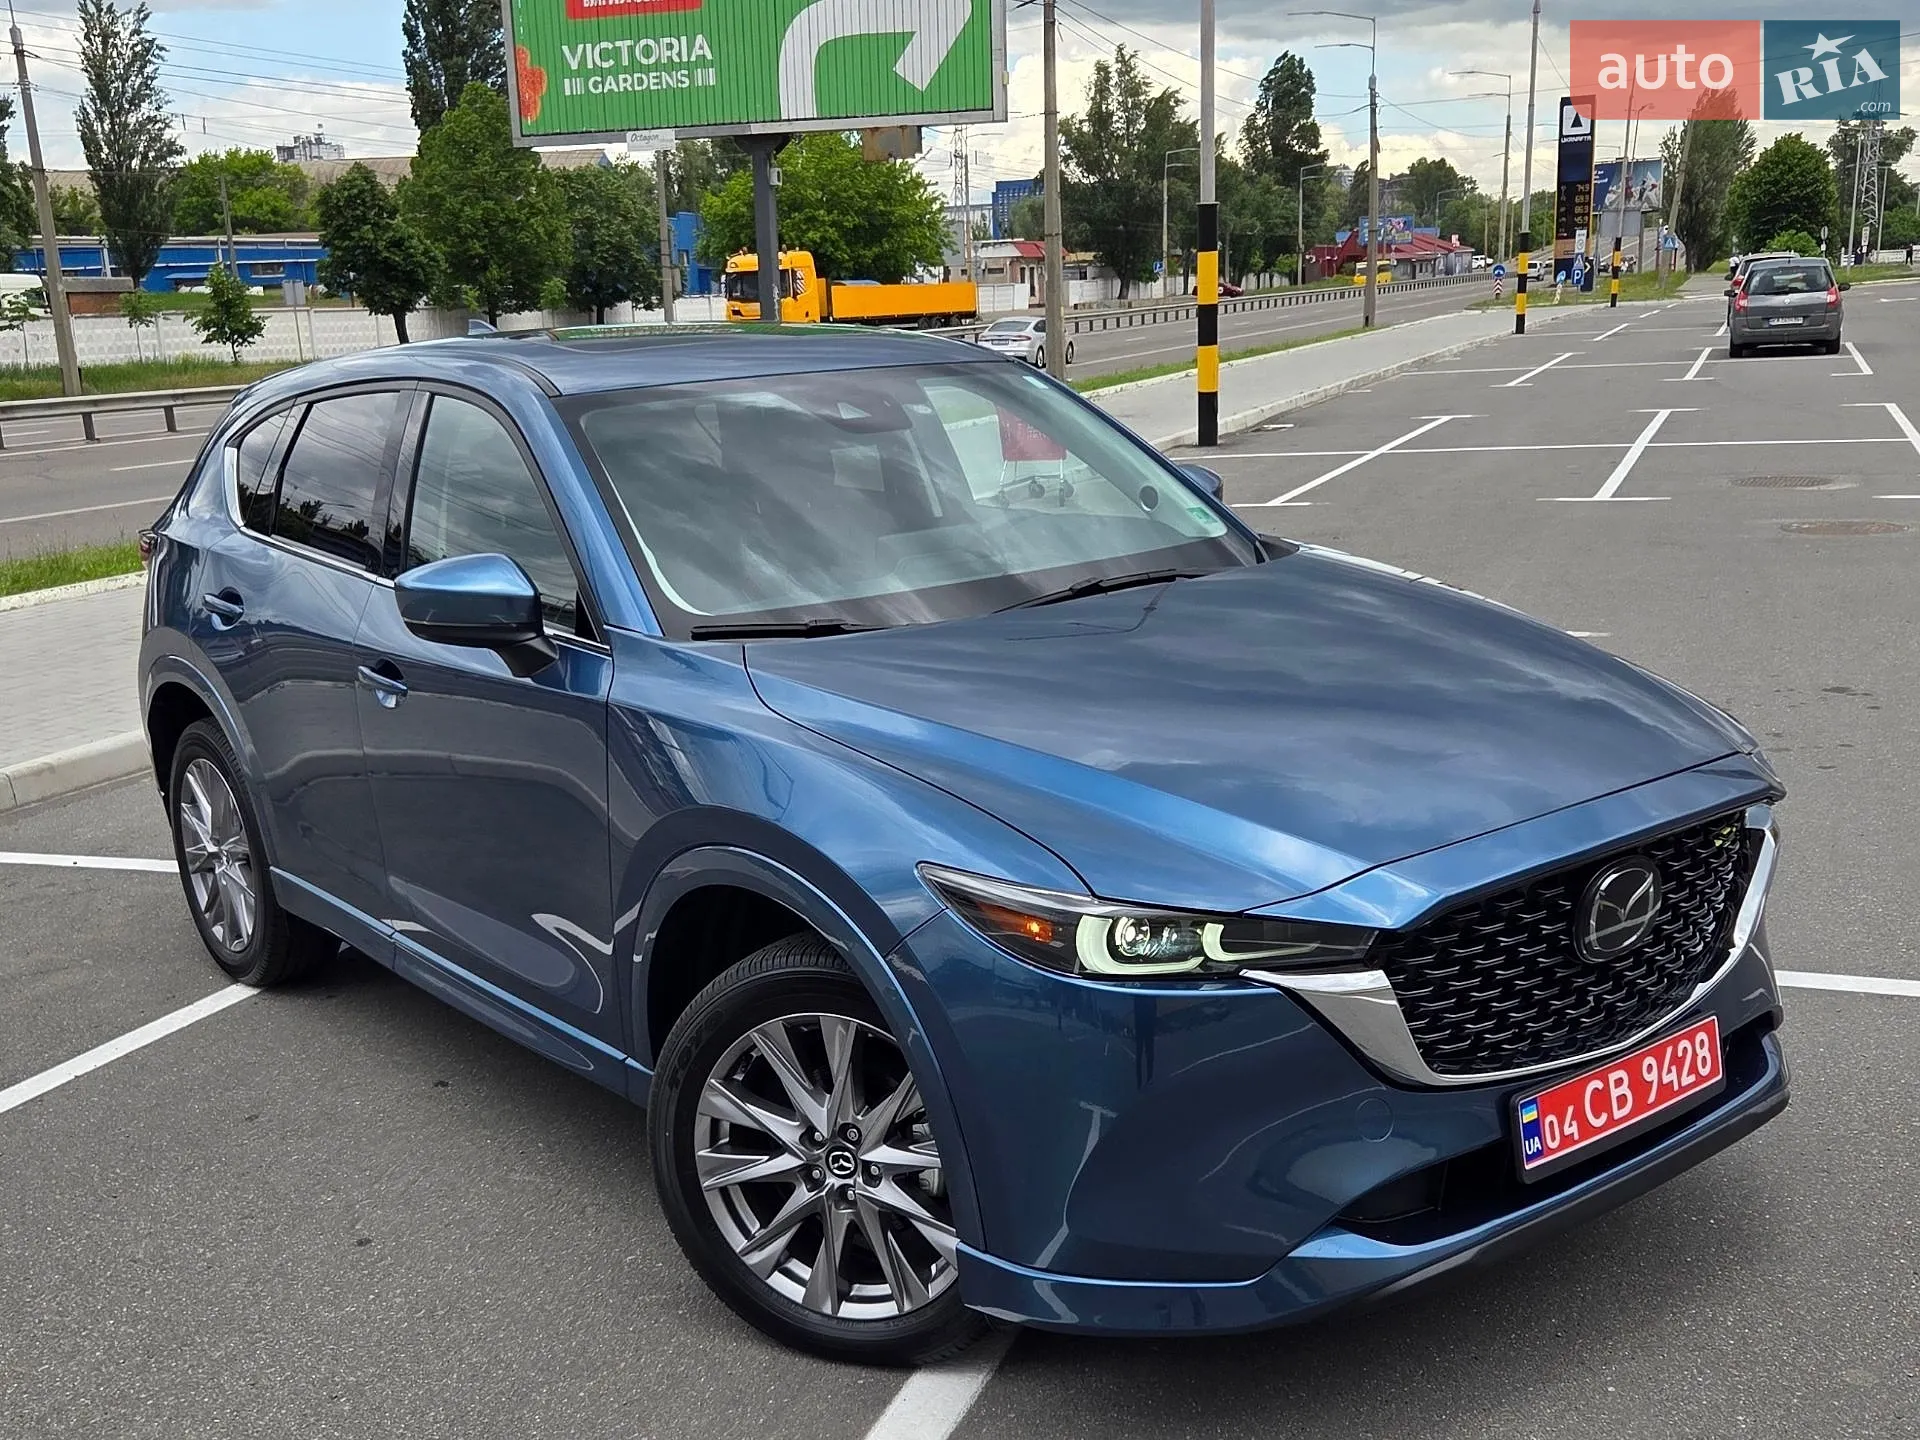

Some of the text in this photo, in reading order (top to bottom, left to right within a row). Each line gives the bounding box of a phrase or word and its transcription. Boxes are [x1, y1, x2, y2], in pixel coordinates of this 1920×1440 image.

[562, 34, 713, 70] VICTORIA
[588, 70, 690, 94] GARDENS
[631, 133, 659, 145] Octagon
[1544, 1031, 1712, 1149] 04 CB 9428
[1525, 1136, 1542, 1155] UA
